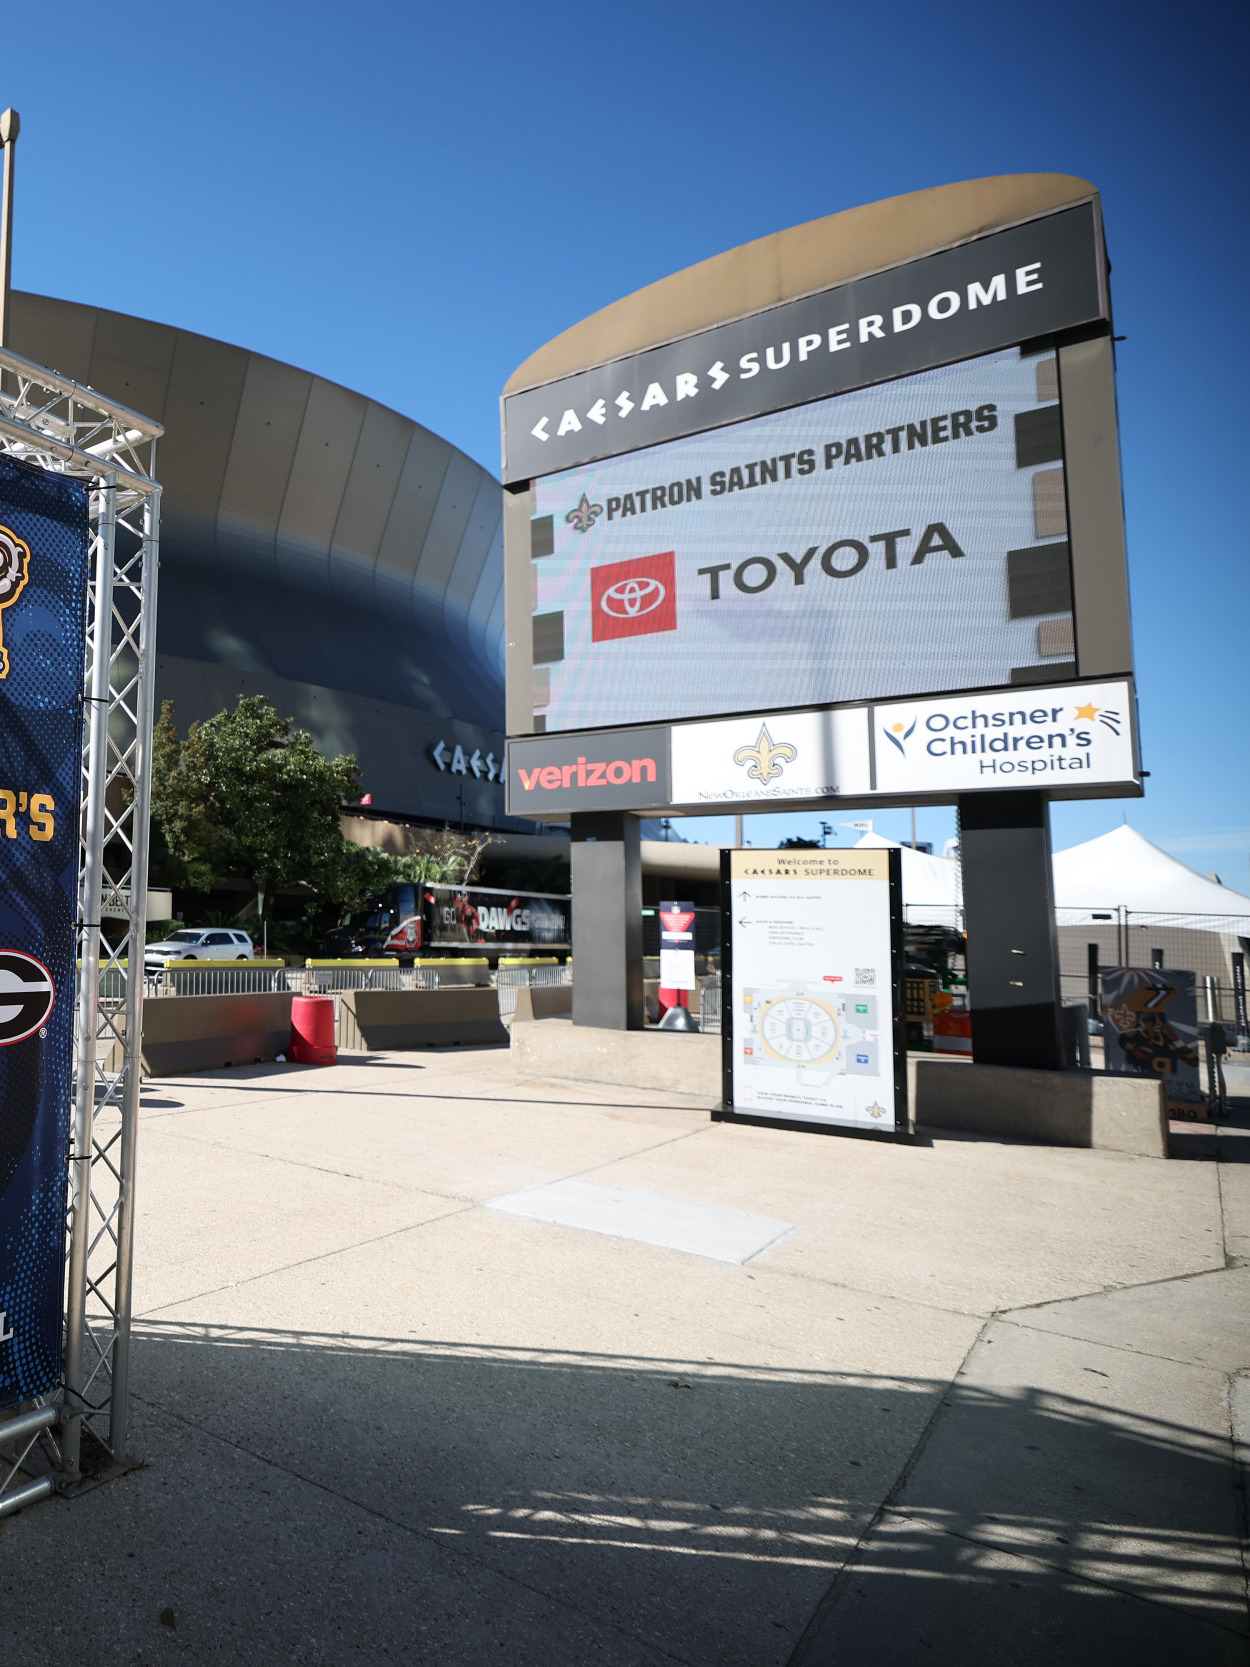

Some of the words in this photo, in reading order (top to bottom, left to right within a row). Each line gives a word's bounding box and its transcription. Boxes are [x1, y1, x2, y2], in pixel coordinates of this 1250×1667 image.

[530, 360, 729, 441] CAESARS
[739, 262, 1044, 379] SUPERDOME
[605, 474, 703, 521] PATRON
[709, 447, 816, 496] SAINTS
[824, 403, 999, 470] PARTNERS
[697, 521, 966, 600] TOYOTA
[925, 706, 1064, 732] Ochsner
[926, 728, 1092, 756] Children's
[518, 757, 657, 791] verizon
[979, 752, 1091, 775] Hospital
[777, 858, 825, 866] Welcome
[828, 858, 840, 866] to
[804, 868, 875, 877] SUPERDOME
[477, 906, 531, 931] DAWGS
